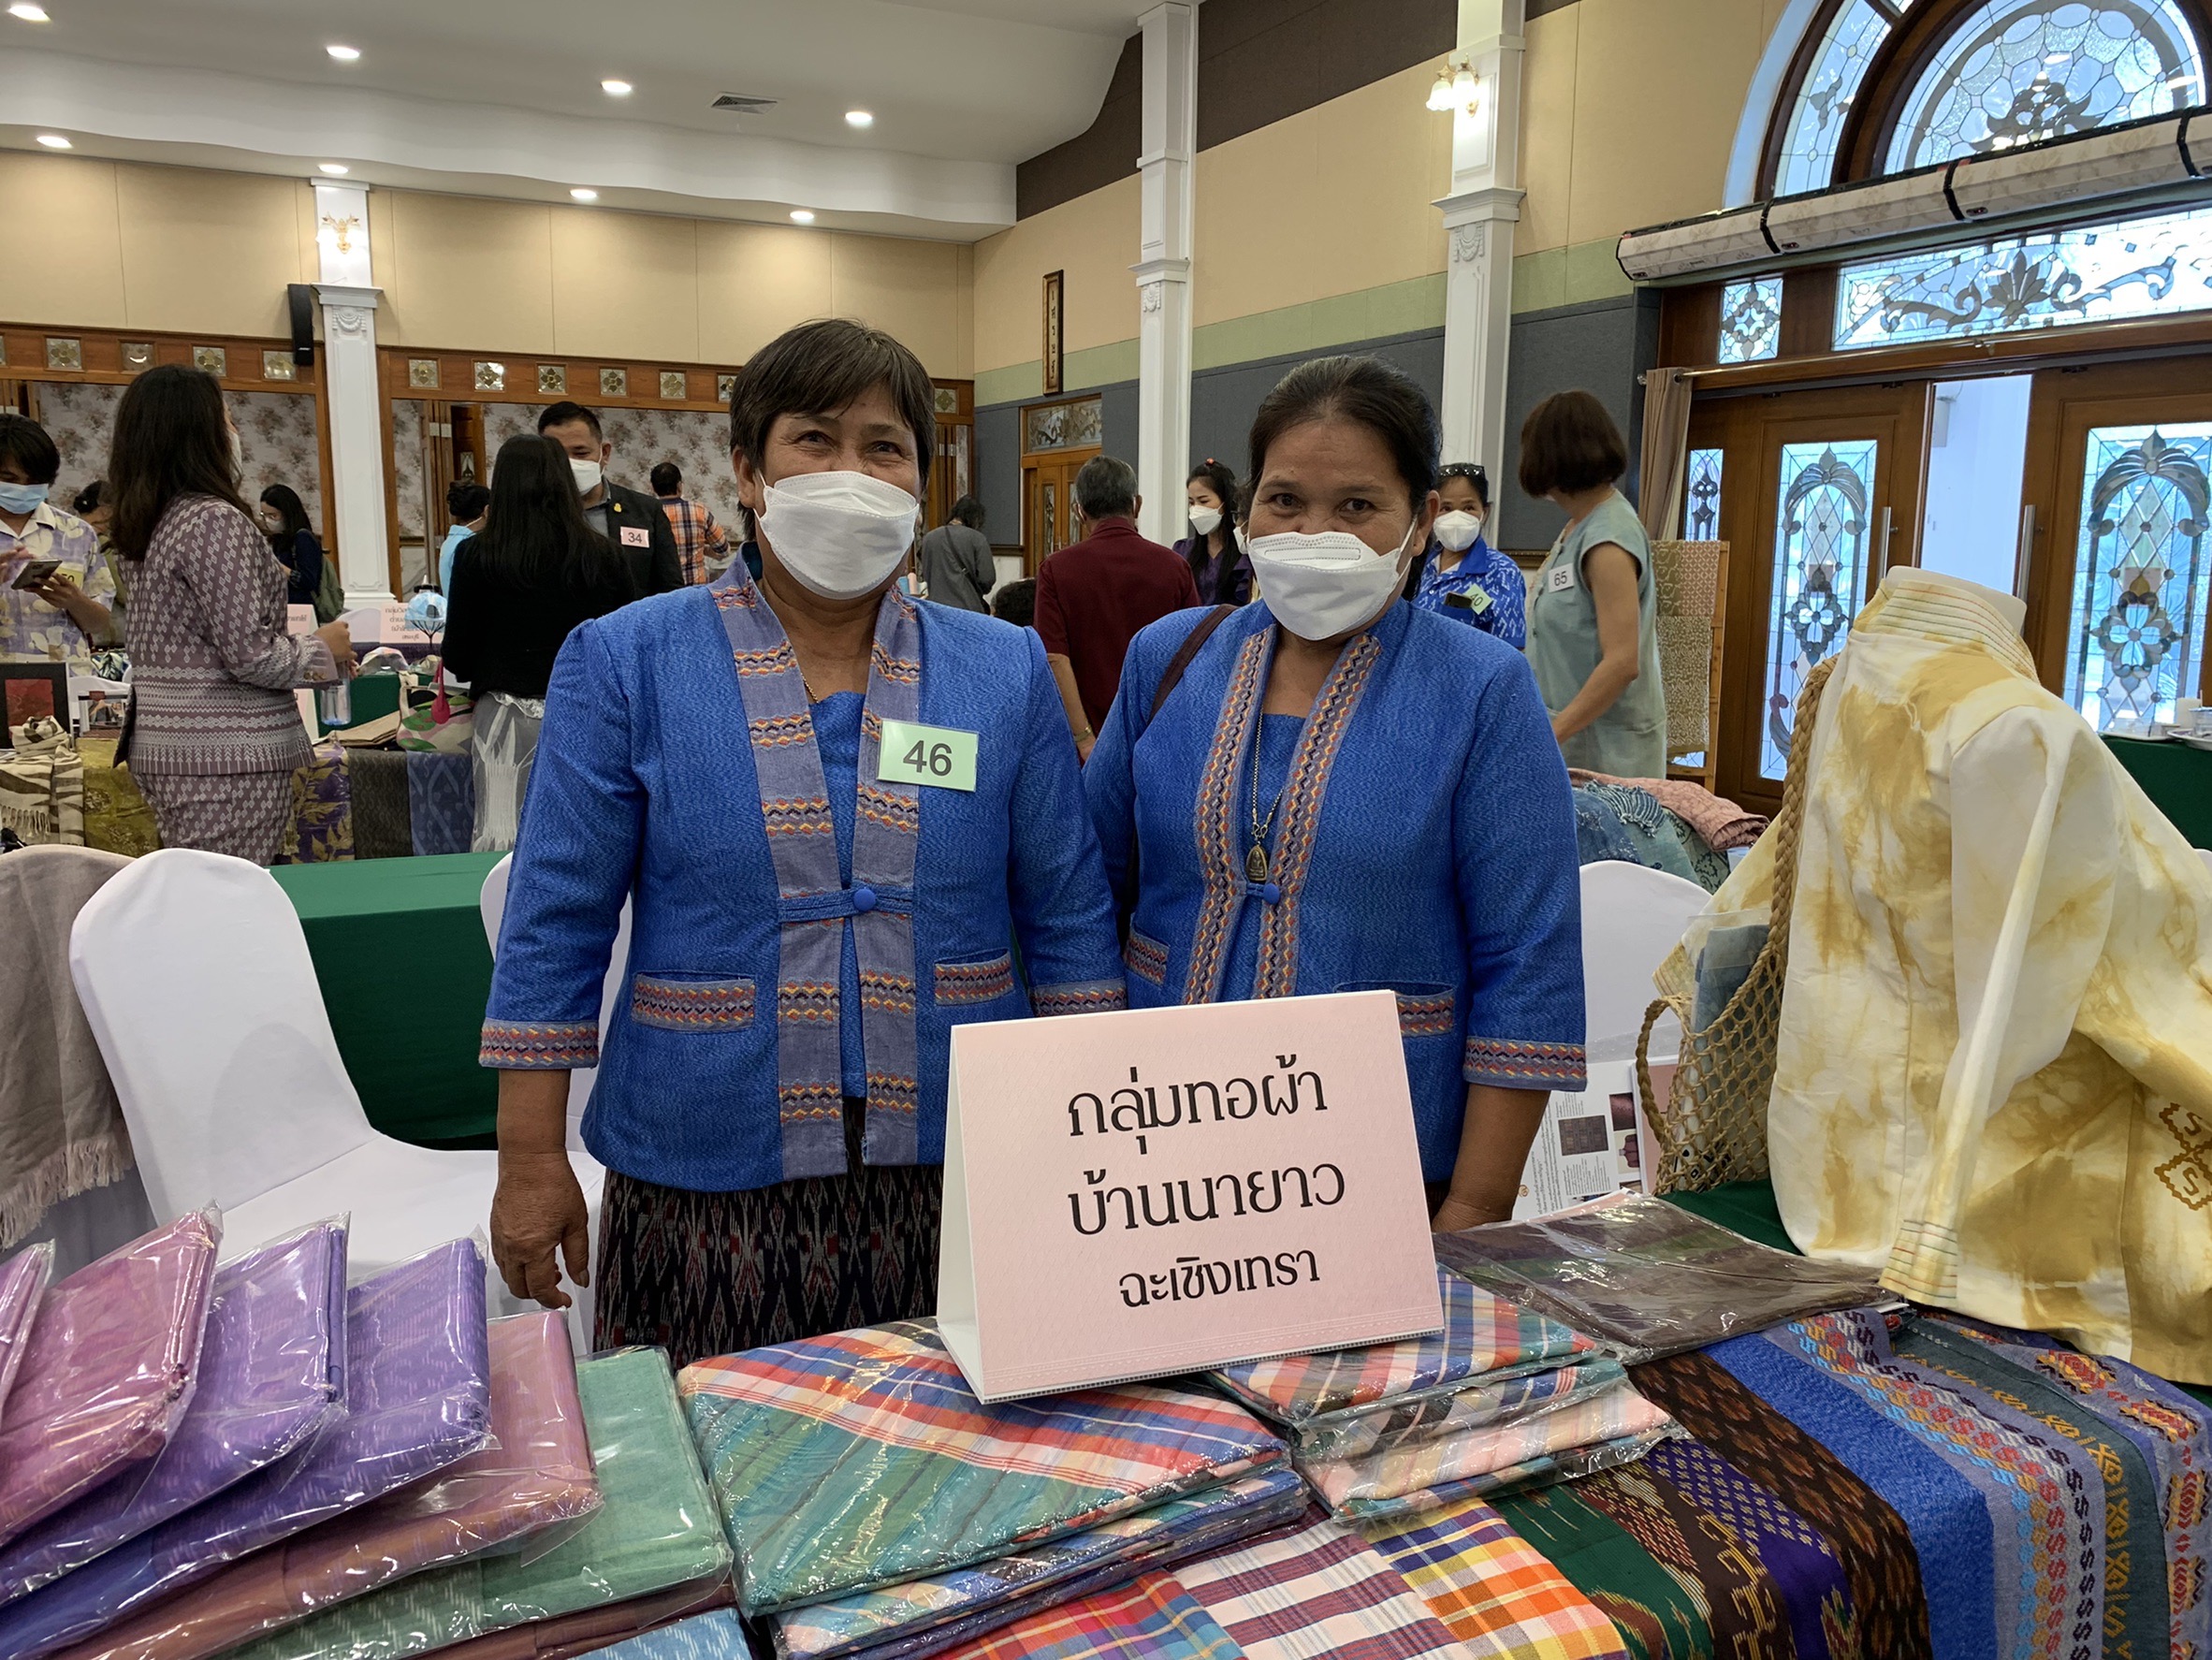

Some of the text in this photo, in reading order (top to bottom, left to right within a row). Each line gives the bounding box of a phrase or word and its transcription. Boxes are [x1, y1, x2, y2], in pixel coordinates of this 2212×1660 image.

[628, 531, 643, 544] 34
[1554, 570, 1567, 587] 65
[903, 739, 953, 777] 46
[1068, 1054, 1328, 1155] กลุ่มทอผ้า
[1068, 1163, 1345, 1235] บ้านนายาว
[1119, 1249, 1320, 1307] ฉะเชิงเทรา
